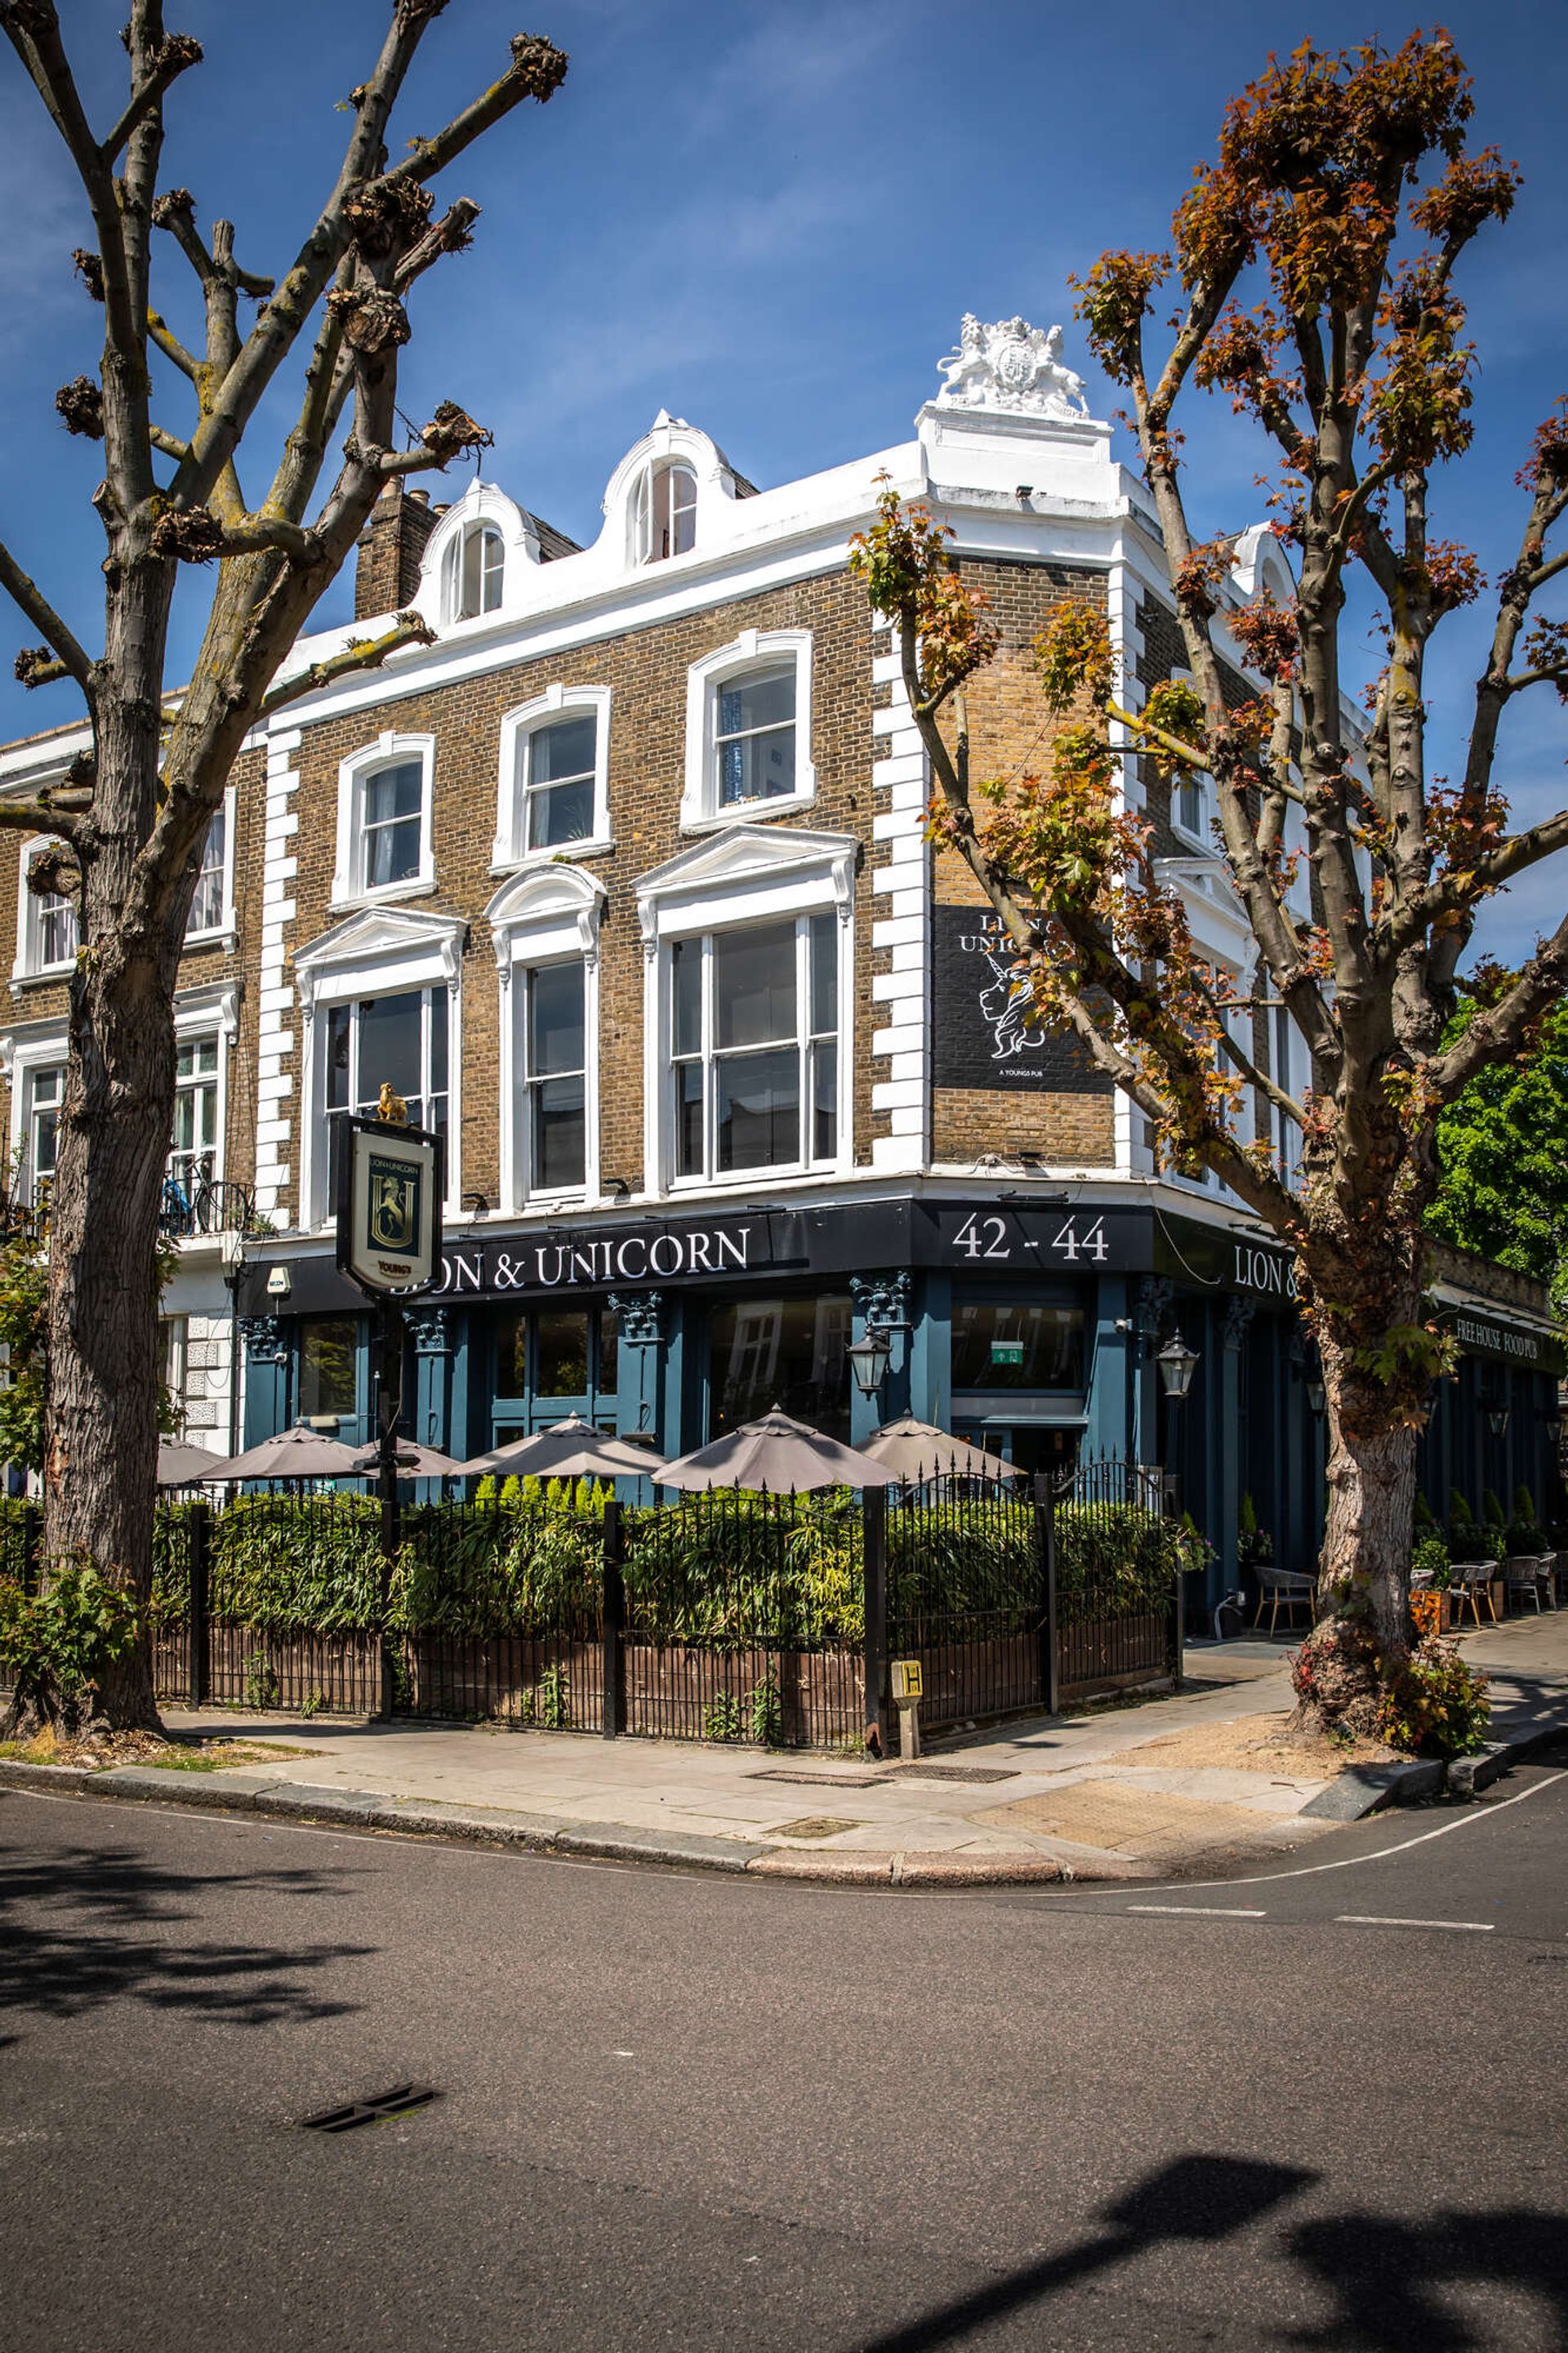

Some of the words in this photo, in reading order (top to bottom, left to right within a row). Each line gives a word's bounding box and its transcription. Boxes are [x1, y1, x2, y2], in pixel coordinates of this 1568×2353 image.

[980, 915, 1042, 931] LIN
[952, 1212, 1010, 1258] 42
[1051, 1214, 1109, 1260] 44
[494, 1254, 525, 1290] &
[536, 1228, 751, 1285] UNICORN
[1235, 1245, 1282, 1294] LION
[1457, 1318, 1476, 1343] FREE
[1476, 1324, 1501, 1350] HOUSE
[1503, 1332, 1524, 1357] FOOD
[906, 1666, 920, 1693] H
